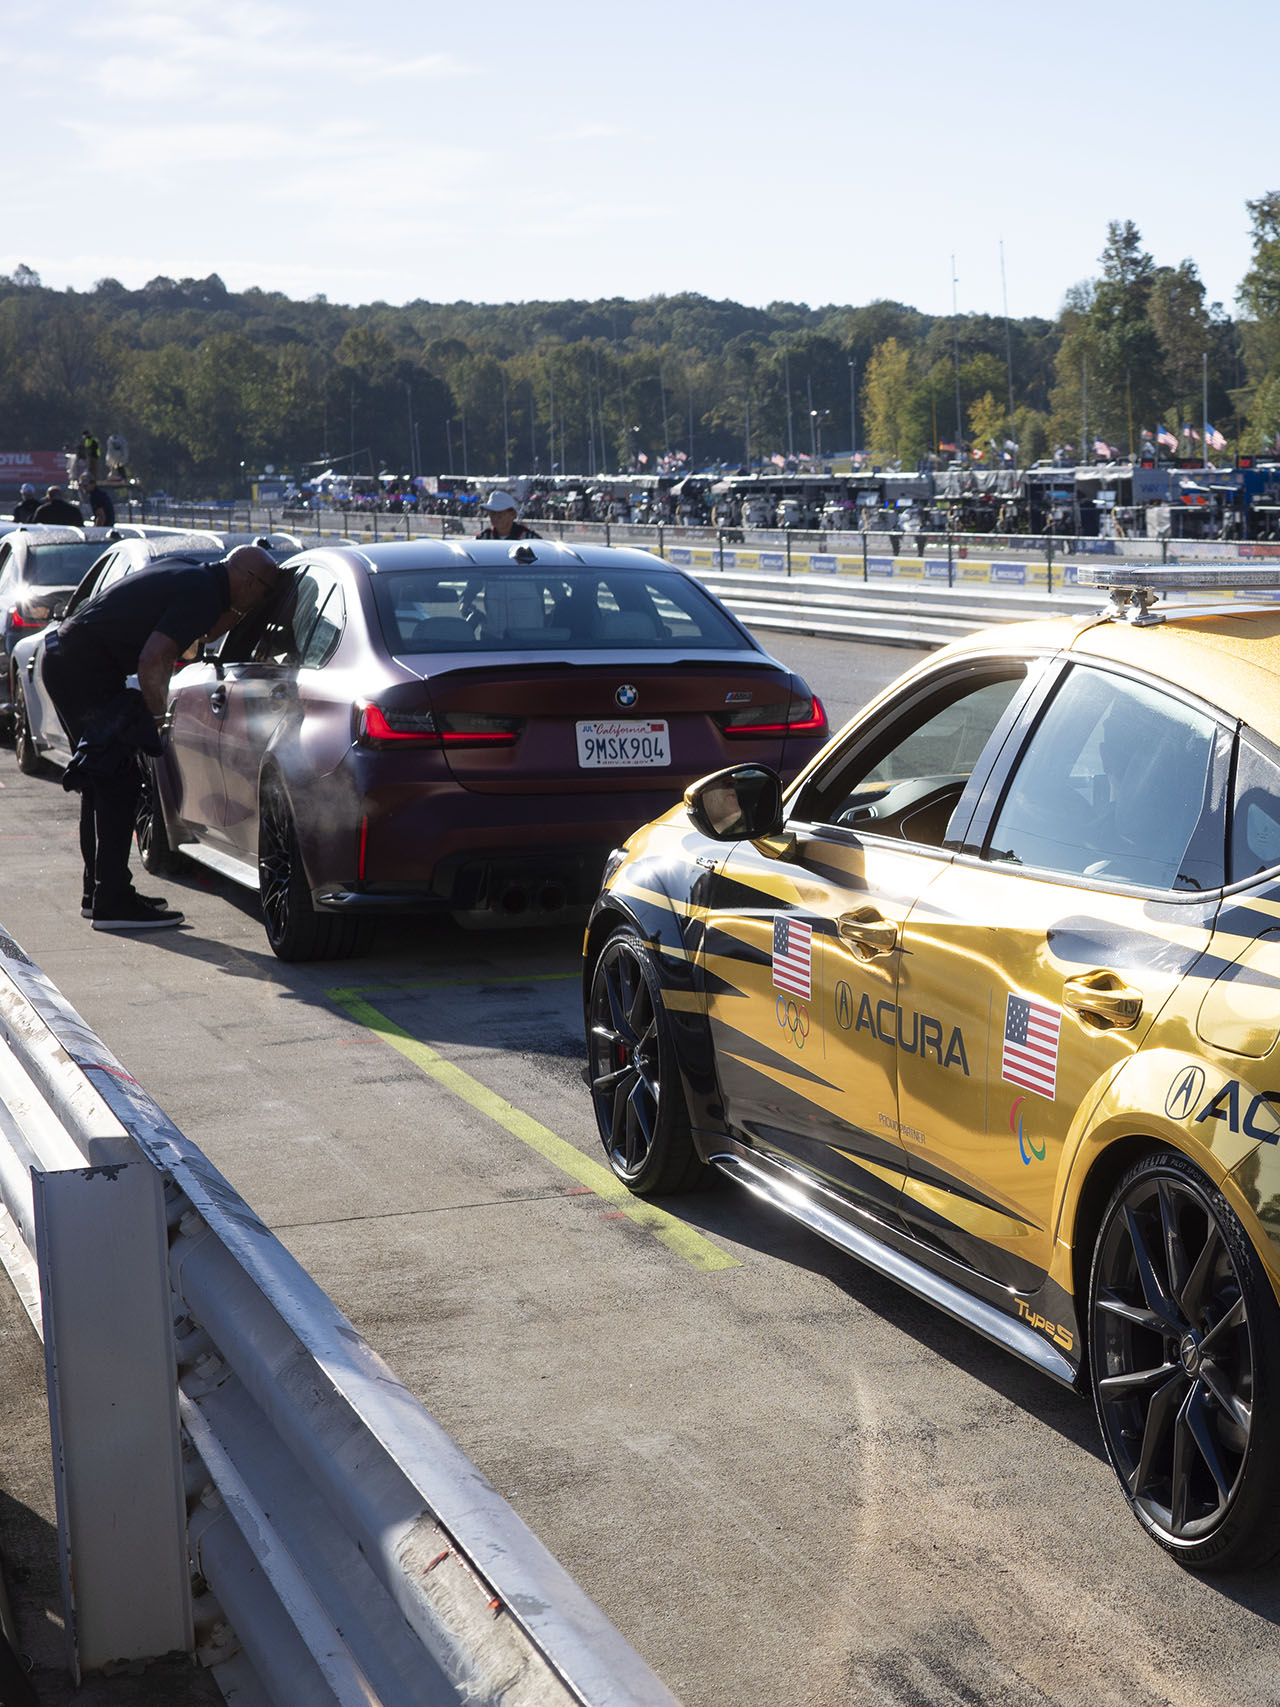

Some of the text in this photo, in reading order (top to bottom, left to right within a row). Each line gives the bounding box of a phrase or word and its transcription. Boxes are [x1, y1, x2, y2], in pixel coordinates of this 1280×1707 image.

[0, 453, 34, 465] OTUL
[596, 723, 650, 737] California
[585, 737, 664, 760] 9MSK904
[855, 992, 970, 1077] ACURA
